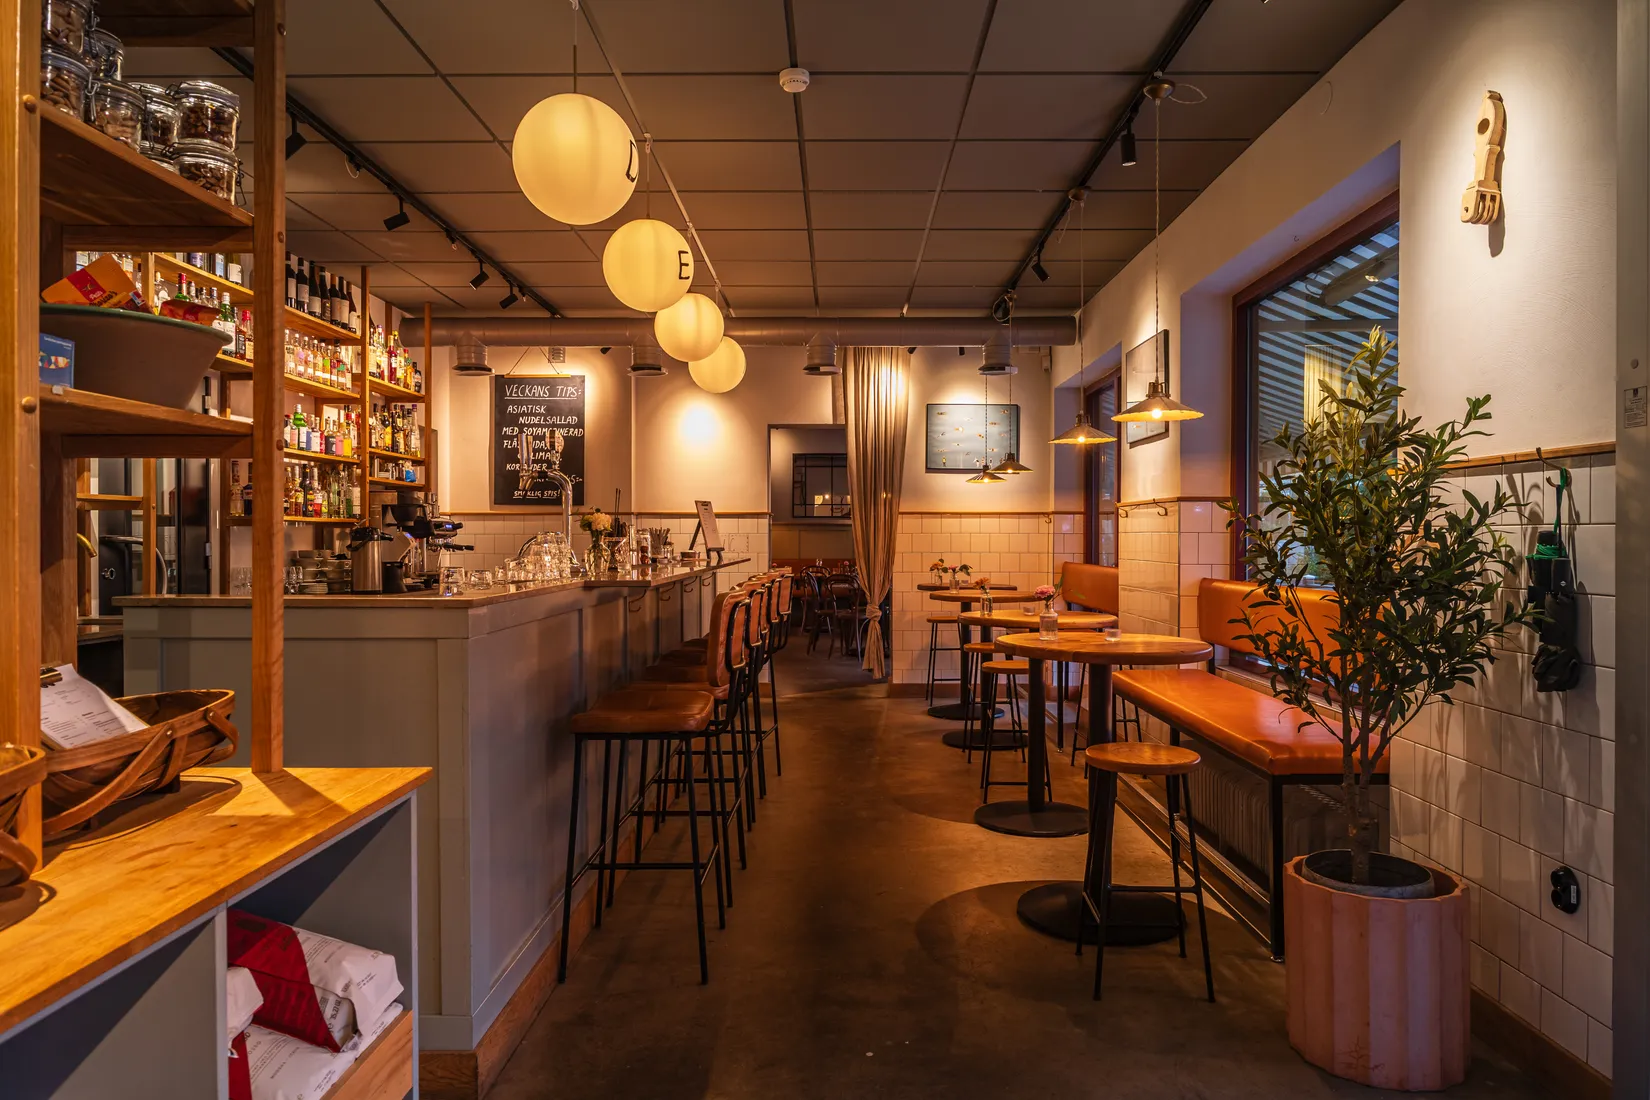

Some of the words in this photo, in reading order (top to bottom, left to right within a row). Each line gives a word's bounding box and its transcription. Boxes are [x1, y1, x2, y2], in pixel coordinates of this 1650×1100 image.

[678, 250, 690, 280] E
[505, 384, 551, 398] VECKANS
[556, 385, 582, 398] TIPS:
[506, 404, 547, 414] ASIATISK
[518, 415, 578, 425] NUDELSALLAD
[501, 426, 519, 436] MED
[523, 426, 584, 437] SOYAMNERAD
